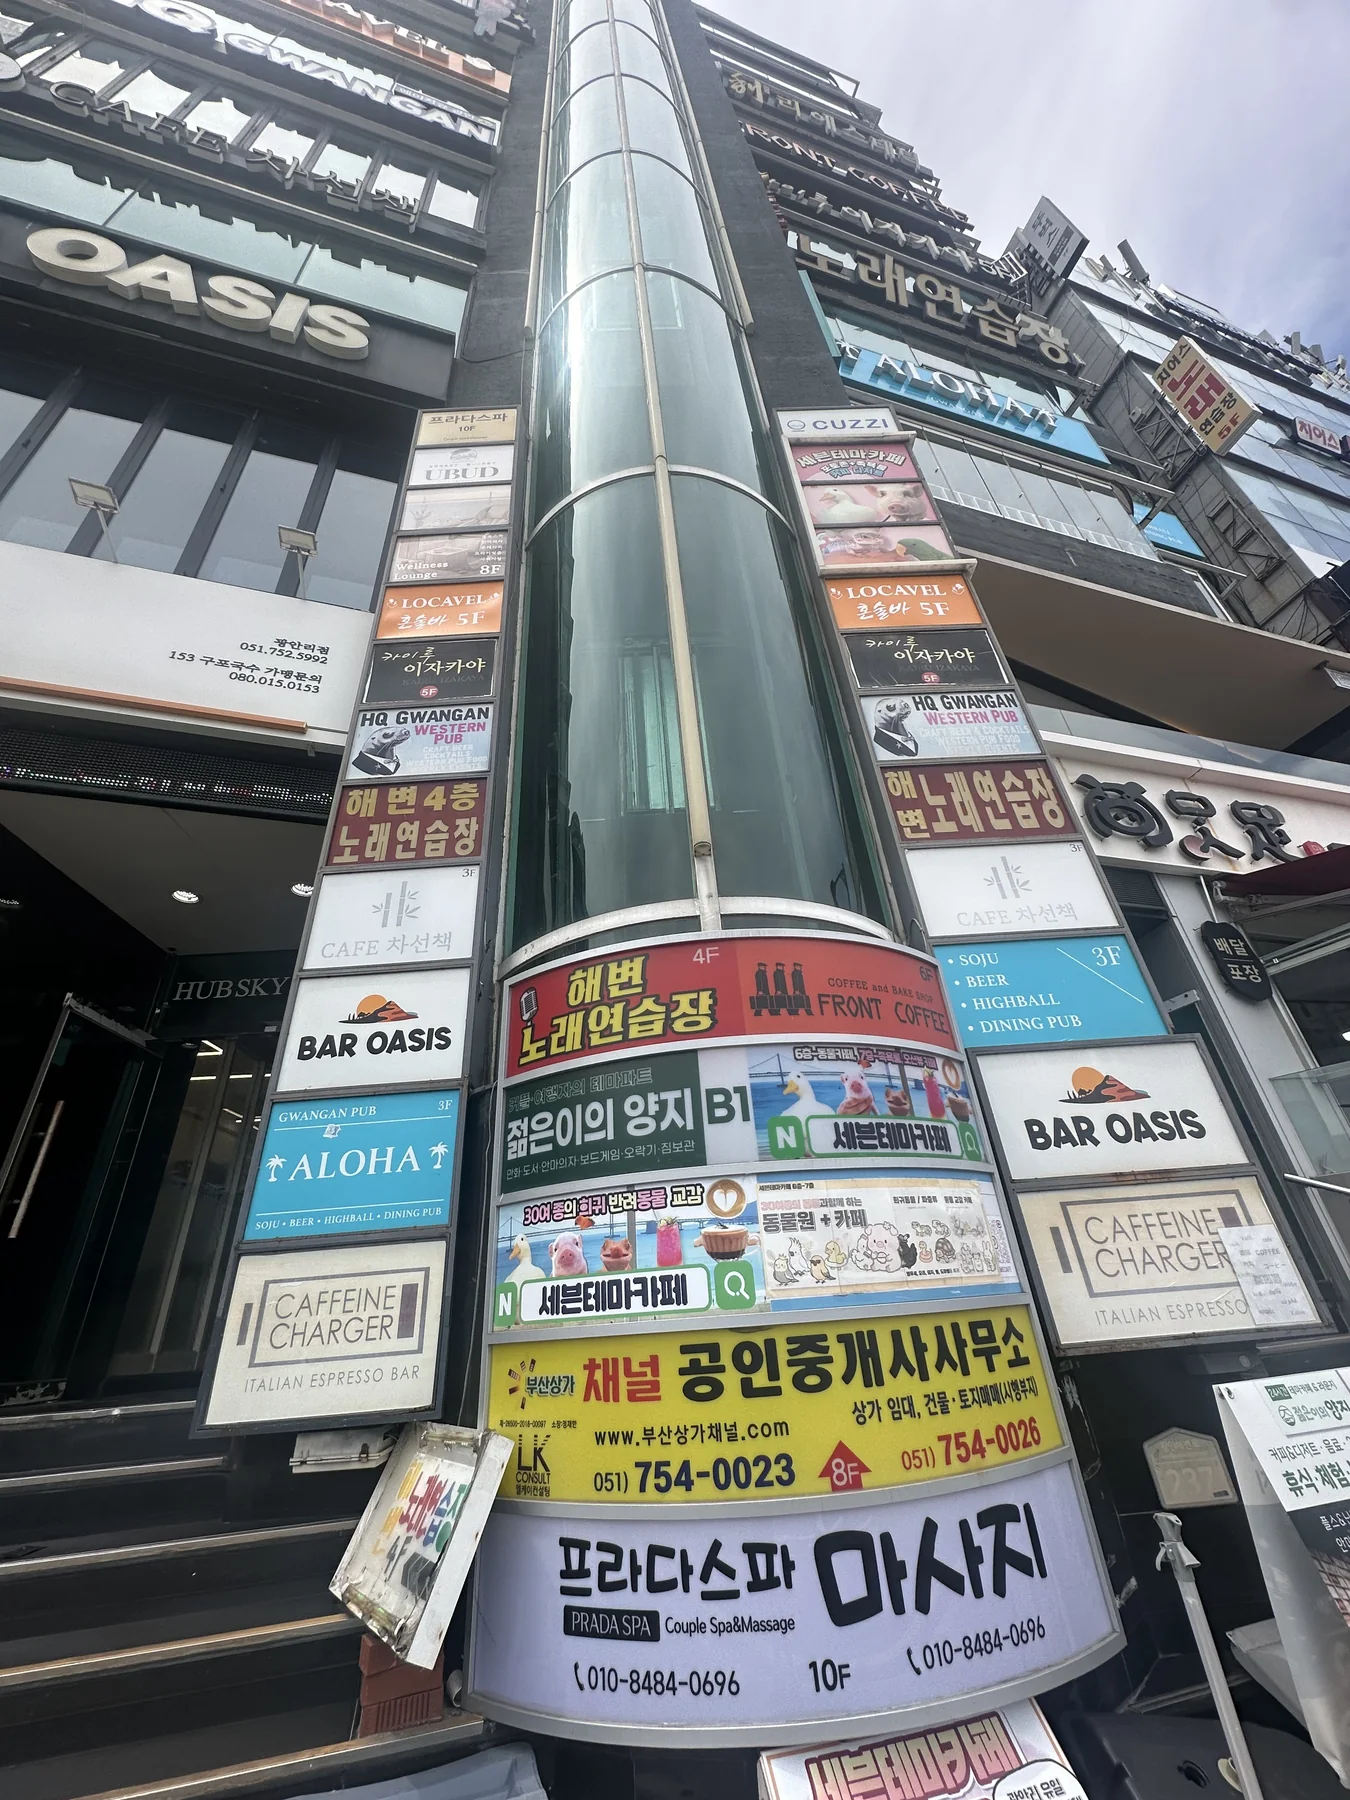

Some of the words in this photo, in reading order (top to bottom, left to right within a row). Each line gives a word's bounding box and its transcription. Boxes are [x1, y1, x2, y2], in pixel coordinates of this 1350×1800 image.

[223, 32, 495, 144] GWANGAN
[738, 120, 836, 168] RONT
[840, 206, 973, 273] 이자카야
[26, 227, 371, 360] OASIS
[795, 232, 1072, 370] 노래연습장
[877, 353, 1031, 420] ALOHA
[1167, 360, 1227, 421] 노래
[428, 413, 508, 424] 프라다스파
[812, 419, 889, 430] CUZZI
[1199, 392, 1238, 437] 연습장
[1217, 413, 1241, 440] 5F
[425, 466, 499, 481] UBUD
[394, 571, 438, 580] Lounge
[397, 561, 449, 571] Wellness
[480, 565, 501, 574] 8F
[401, 593, 487, 609] LOCAVEL
[847, 584, 946, 599] LOCAVEL
[397, 613, 450, 629] 혼술바
[456, 611, 486, 626] 5F
[856, 601, 911, 620] 혼술바
[919, 602, 950, 616] 5F
[240, 642, 329, 665] 051.752.5992
[274, 638, 330, 655] 광안리점
[382, 647, 435, 665] 카이루
[865, 636, 919, 652] 카이루
[894, 648, 976, 664] 이자카야
[169, 651, 195, 662] 153
[200, 656, 261, 673] 구포국수
[265, 667, 323, 684] 가맹문의
[404, 658, 486, 677] 이자카야
[924, 674, 939, 682] 5F
[229, 672, 321, 694] 080.015.0153
[421, 688, 437, 696] 5F
[912, 696, 939, 711] HQ
[942, 694, 1018, 710] GWANGAN
[360, 712, 388, 727] HQ
[396, 707, 490, 725] GWANGAN
[415, 721, 487, 735] WESTERN
[924, 711, 989, 725] WESTERN
[990, 709, 1019, 723] PUB
[433, 733, 463, 744] PUB
[884, 770, 931, 839] 해변
[919, 767, 1065, 833] 노래연습장
[332, 816, 480, 864] 노래연습장
[1069, 843, 1083, 852] 3F
[462, 868, 477, 877] 3F
[956, 910, 1012, 926] CAFE
[1015, 902, 1078, 924] 차선책
[321, 939, 380, 958] CAFE
[386, 931, 452, 955] 차선책
[692, 947, 719, 964] 4F
[1091, 945, 1121, 967] 3F
[1213, 937, 1248, 956] 배달
[959, 952, 999, 968] SOJU
[567, 954, 647, 1007] 해변
[919, 965, 934, 983] 6F
[965, 974, 1010, 988] BEER
[1227, 964, 1262, 983] 포장
[827, 977, 868, 990] COFFEE
[872, 982, 889, 993] and
[891, 985, 914, 998] BAKE
[915, 990, 933, 1003] SHOP
[972, 993, 1060, 1011] HIGHBALL
[519, 988, 717, 1066] 노래연습장
[817, 993, 882, 1020] FRONT
[894, 1001, 949, 1035] COFFEE
[979, 1017, 1044, 1033] DINING
[1046, 1014, 1082, 1030] PUB
[297, 1033, 358, 1061] BAR
[366, 1026, 452, 1055] OASIS
[279, 1107, 348, 1123] GWANGAN
[351, 1106, 377, 1117] PUB
[438, 1100, 453, 1110] 3F
[507, 1098, 614, 1161] 젊은이의
[623, 1088, 694, 1137] 양지
[705, 1086, 751, 1125] B1
[1024, 1115, 1101, 1151] BAR
[1105, 1109, 1206, 1145] OASIS
[775, 1125, 797, 1149] N
[833, 1121, 952, 1153] 세븐테마카페
[288, 1145, 421, 1181] ALOHA
[553, 1200, 579, 1220] 종의
[579, 1196, 606, 1216] 희귀
[607, 1188, 668, 1213] 반려동물
[669, 1183, 705, 1207] 교감
[255, 1220, 280, 1230] SOJU
[289, 1217, 314, 1227] BEER
[324, 1213, 375, 1224] HIGHBALL
[384, 1209, 420, 1220] DINING
[422, 1207, 442, 1216] PUB
[762, 1211, 817, 1234] 동물원
[834, 1208, 868, 1229] 카페
[1084, 1208, 1220, 1245] CAFFEINE
[1095, 1240, 1234, 1278] CHARGER
[275, 1284, 397, 1319] CAFFEINE
[498, 1292, 511, 1317] N
[539, 1273, 689, 1316] 세븐테마카페
[1094, 1305, 1161, 1326] ITALIAN
[1169, 1298, 1248, 1322] ESPRESSO
[269, 1314, 394, 1350] CHARGER
[526, 1374, 575, 1397] 부산상가
[583, 1354, 661, 1403] 채널
[678, 1317, 1030, 1403] 공인중개사사무소
[244, 1374, 304, 1393] ITALIAN
[310, 1368, 384, 1388] ESPRESSO
[391, 1365, 420, 1381] BAR
[852, 1399, 882, 1426] 상가
[887, 1395, 921, 1421] 임대,
[595, 1418, 790, 1447] www.부산상가채널.com
[901, 1447, 936, 1471] 051)
[938, 1416, 1041, 1466] 754-0026
[518, 1434, 551, 1472] LK
[516, 1472, 551, 1485] CONSULT
[593, 1471, 629, 1494] 051)
[634, 1452, 796, 1494] 754-0023
[831, 1457, 860, 1487] 8F
[384, 1535, 413, 1582] 4F
[558, 1536, 796, 1600] 프라다스파
[813, 1502, 1048, 1627] 마사지
[571, 1611, 620, 1635] PRADA
[622, 1615, 652, 1637] SPA
[665, 1616, 707, 1637] Couple
[709, 1615, 796, 1637] Spa&Massage
[588, 1665, 740, 1696] 010-8484-0696
[808, 1658, 851, 1693] 10F
[923, 1616, 1046, 1669] 010-8484-0696
